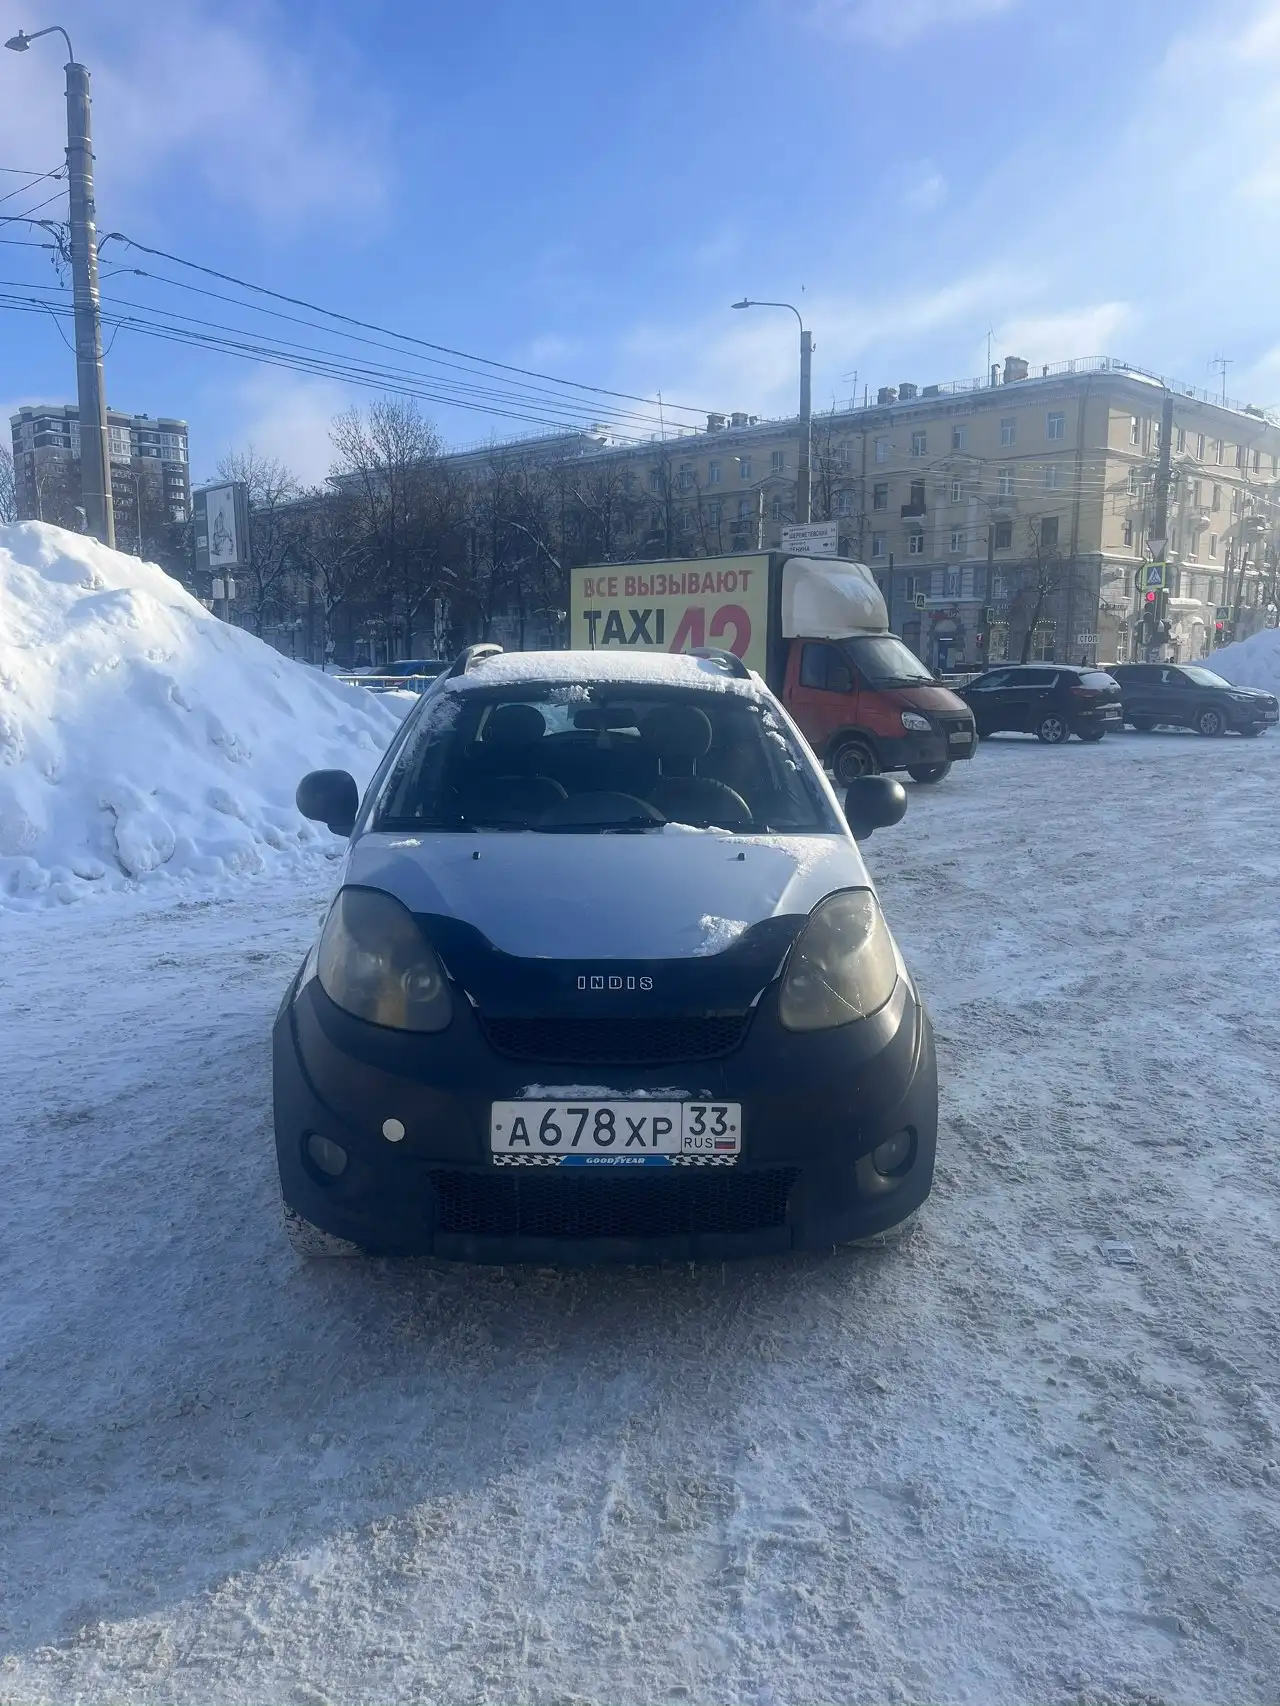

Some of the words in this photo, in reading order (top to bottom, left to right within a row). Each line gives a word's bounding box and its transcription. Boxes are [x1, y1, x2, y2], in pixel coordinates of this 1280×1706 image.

[583, 577, 618, 598] ВСЕ
[624, 570, 754, 597] ВЫЗЫВАЮТ
[577, 976, 653, 990] INDIS
[688, 1106, 728, 1135] 33
[684, 1137, 713, 1148] RUS
[585, 1157, 646, 1166] GOODYEAR
